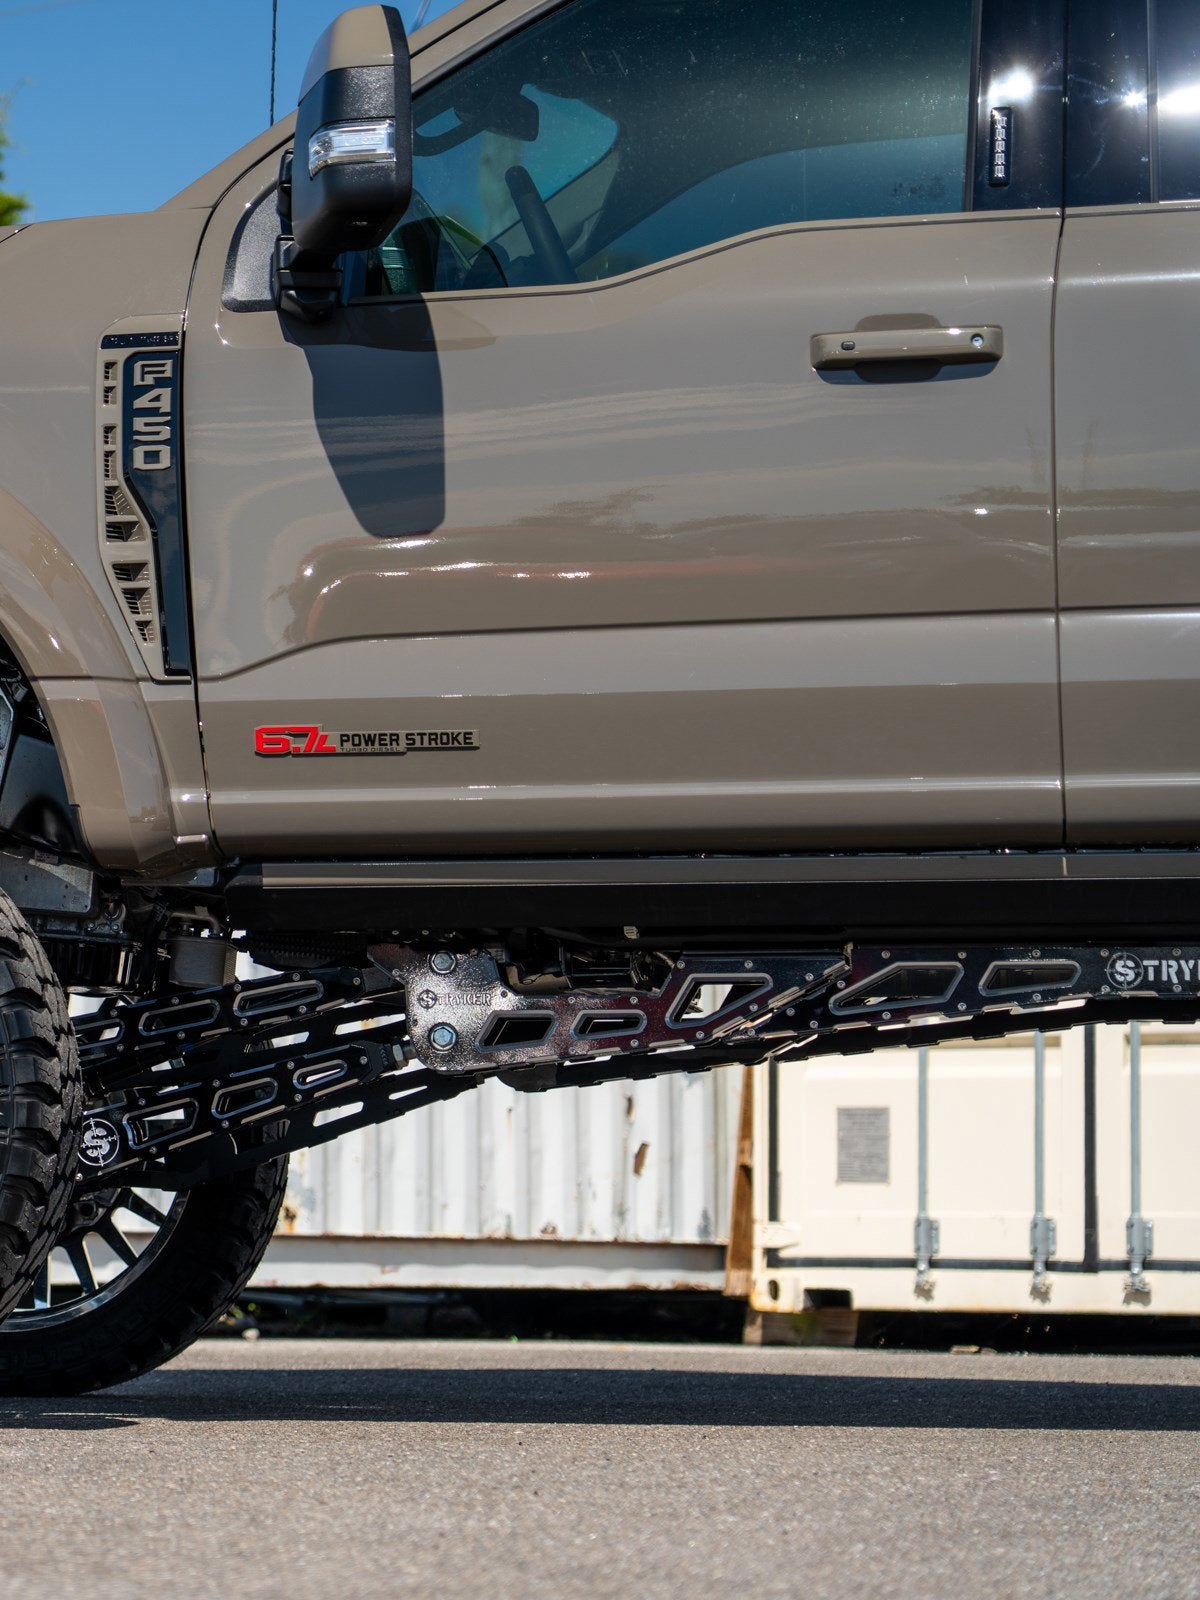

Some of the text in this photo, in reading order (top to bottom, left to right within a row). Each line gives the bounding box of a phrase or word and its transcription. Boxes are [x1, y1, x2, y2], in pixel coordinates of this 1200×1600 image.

[133, 360, 173, 471] F450
[340, 732, 400, 747] POWER
[406, 731, 474, 746] STROKE
[1114, 959, 1200, 985] STRY
